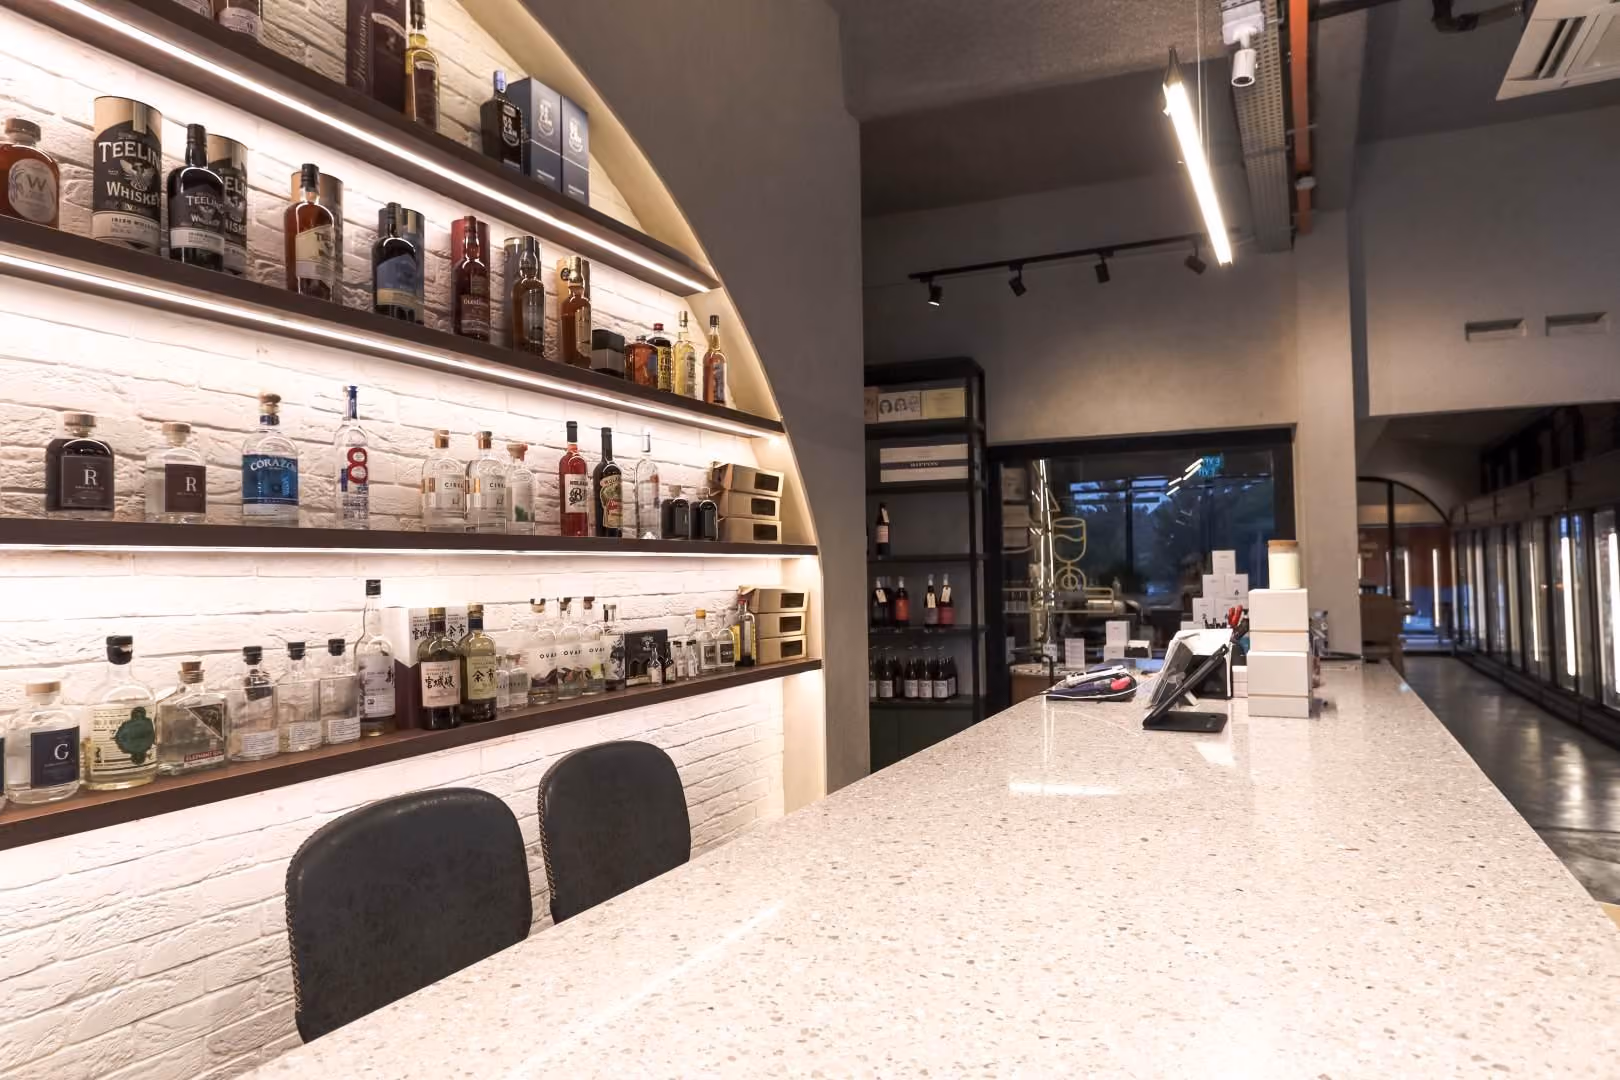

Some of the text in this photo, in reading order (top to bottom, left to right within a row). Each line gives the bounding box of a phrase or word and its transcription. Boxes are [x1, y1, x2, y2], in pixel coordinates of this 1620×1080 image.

[98, 141, 161, 171] TEELIN
[84, 469, 98, 485] R
[186, 476, 197, 492] R
[54, 743, 69, 760] G
